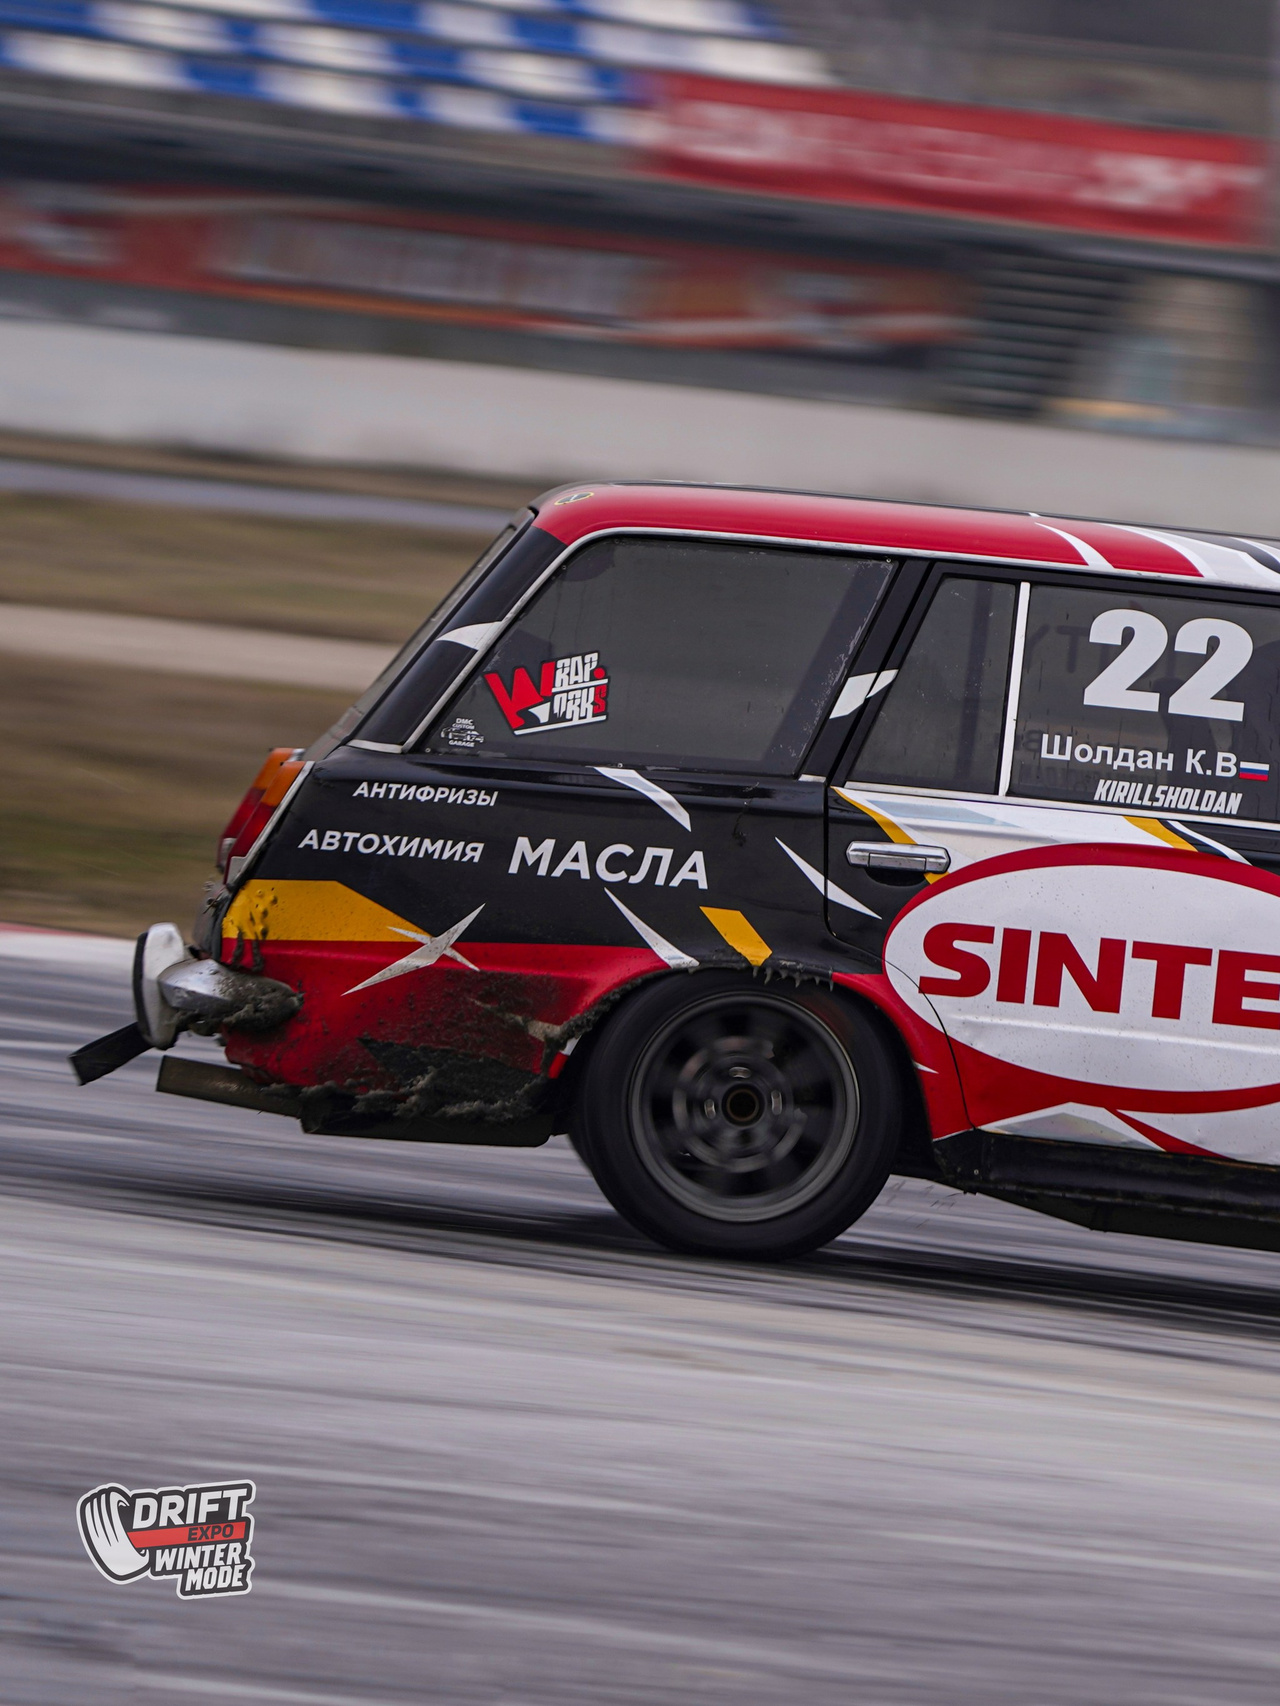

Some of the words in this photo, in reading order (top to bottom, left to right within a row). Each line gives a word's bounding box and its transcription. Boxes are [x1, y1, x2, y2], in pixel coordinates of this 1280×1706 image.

[1083, 609, 1254, 721] 22
[1040, 733, 1174, 772] Шолдан
[352, 781, 499, 807] АНТИФРИЗЫ
[1093, 779, 1242, 815] KIRILLSHOLDAN
[298, 829, 485, 863] АВТОХИМИЯ
[508, 836, 709, 890] МАСЛА
